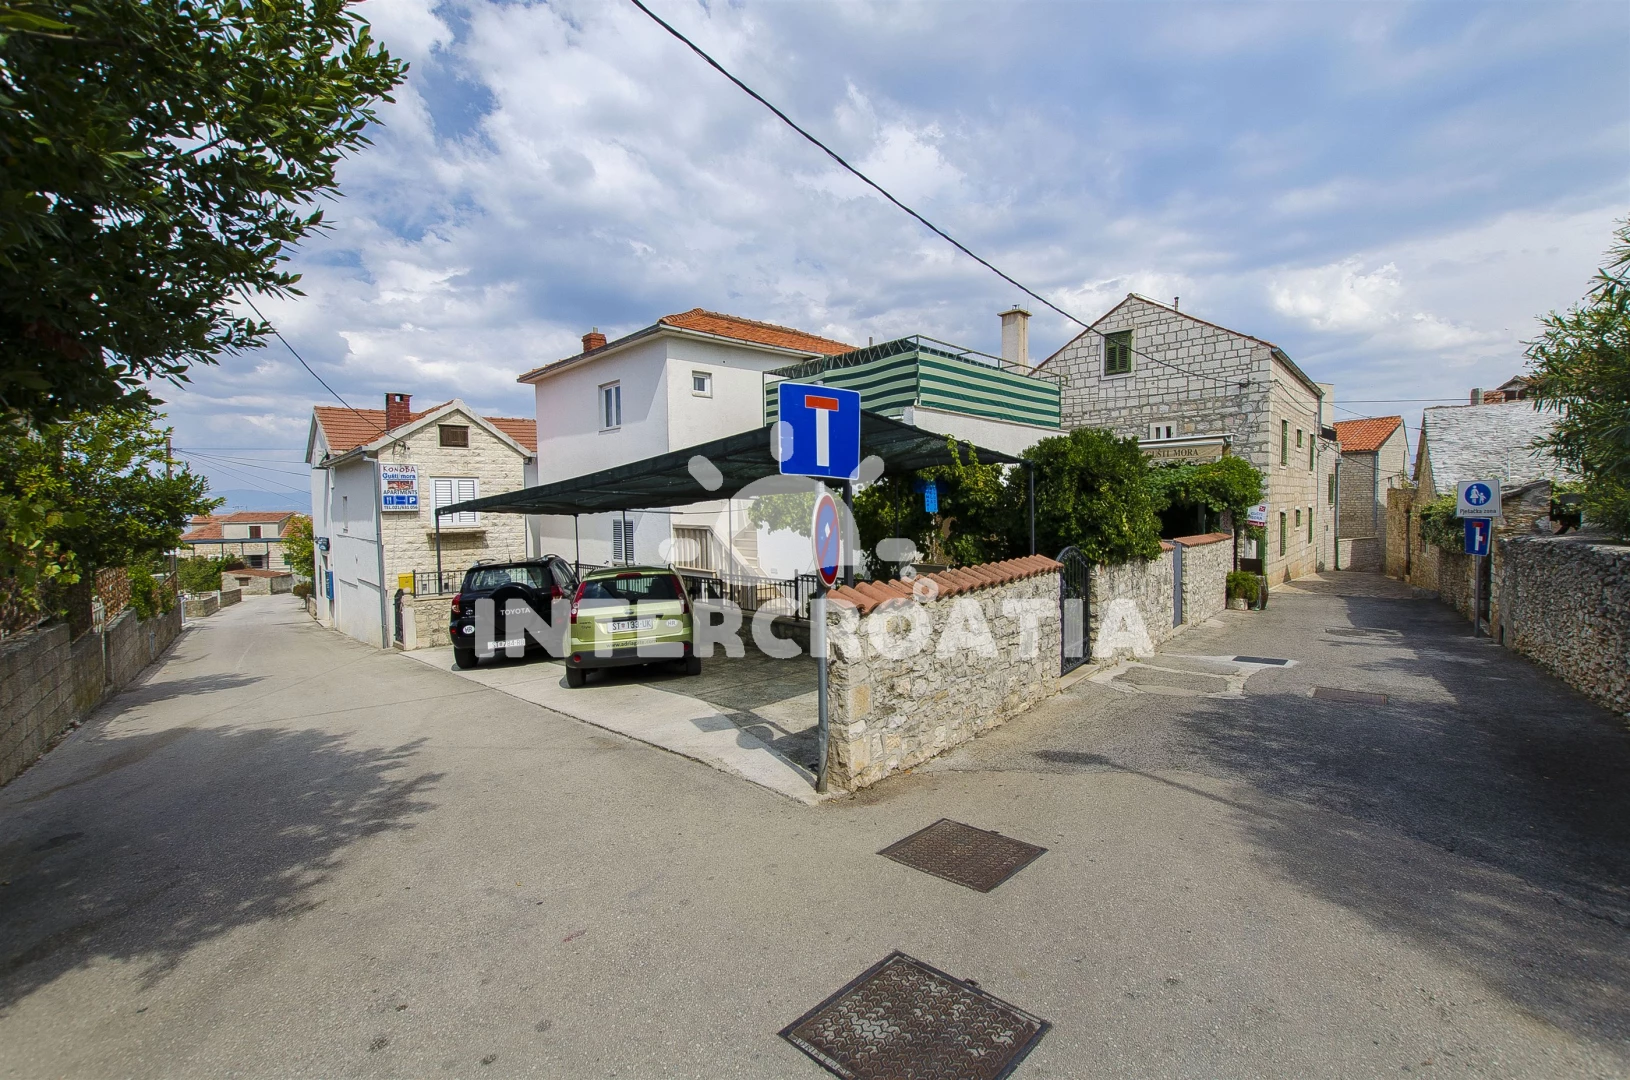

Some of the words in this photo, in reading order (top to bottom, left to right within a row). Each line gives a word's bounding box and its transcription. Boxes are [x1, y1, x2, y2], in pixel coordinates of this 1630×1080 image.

[1173, 449, 1199, 457] MORA
[500, 607, 531, 616] TOYOTA
[612, 622, 620, 631] ST
